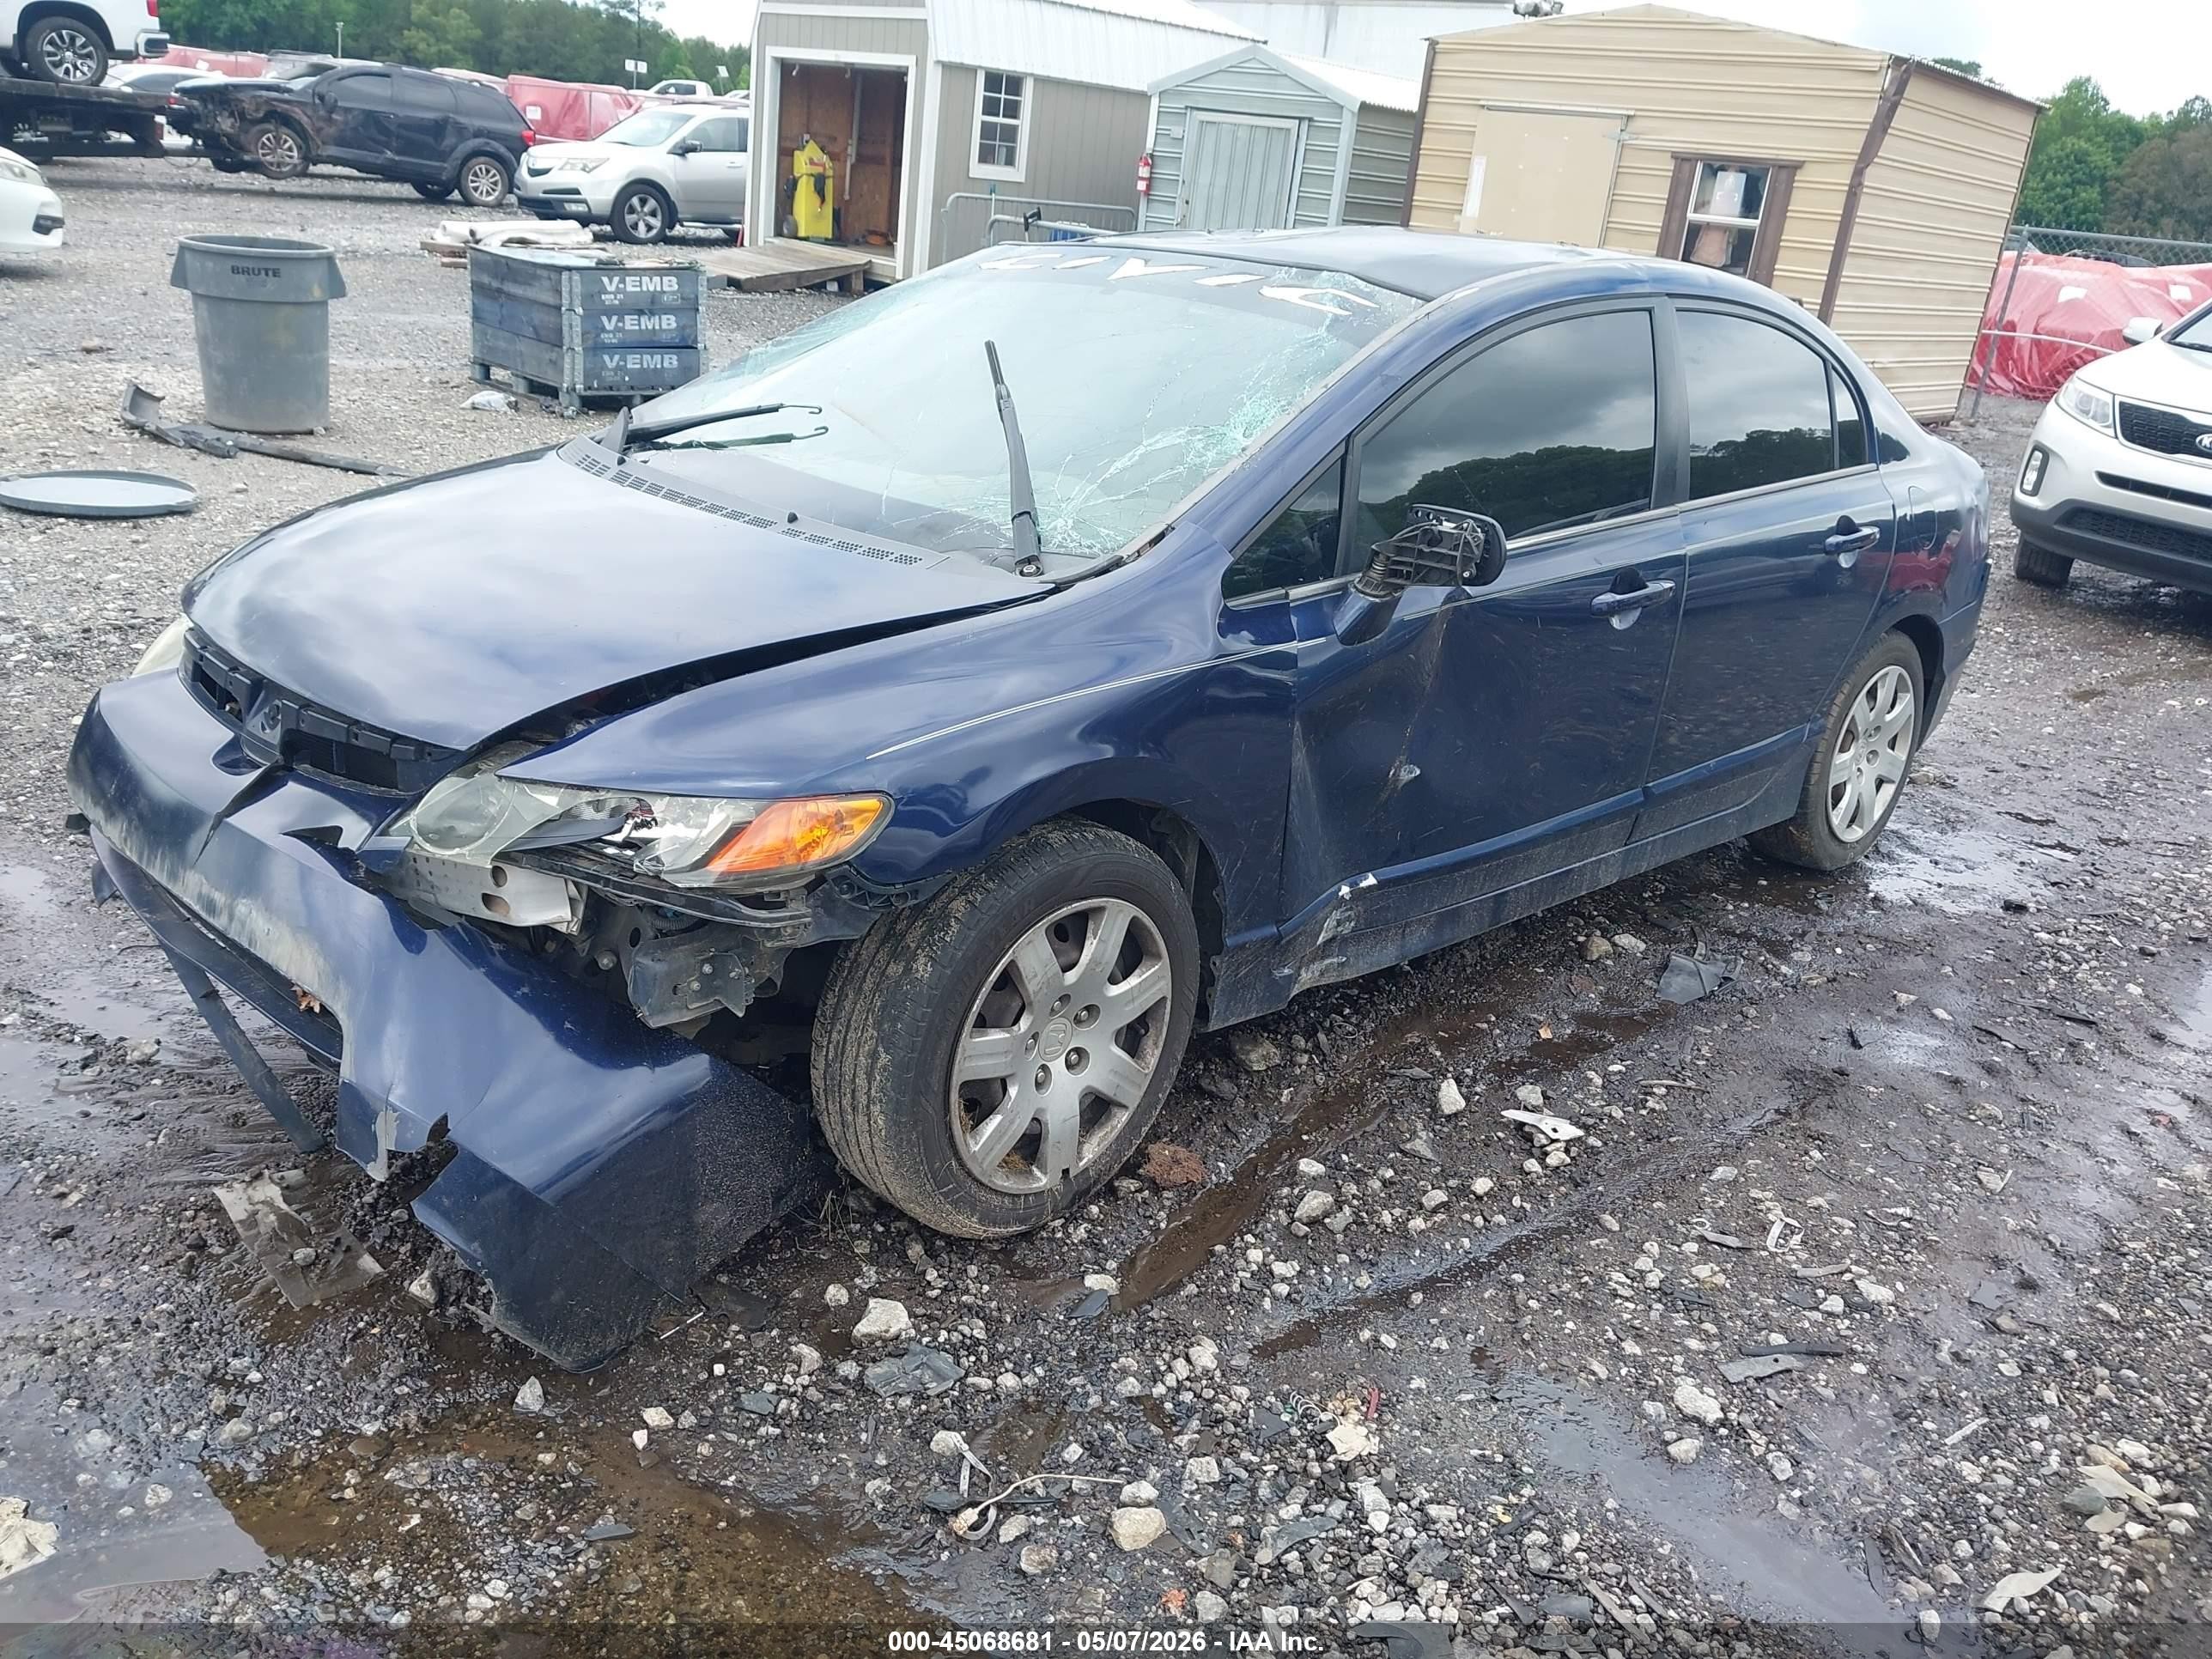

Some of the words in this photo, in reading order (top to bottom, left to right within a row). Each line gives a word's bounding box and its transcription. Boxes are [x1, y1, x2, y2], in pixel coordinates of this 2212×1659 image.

[231, 264, 282, 278] BRUTE
[601, 276, 679, 292] V-EMB
[600, 314, 678, 331] V-EMB
[603, 354, 678, 368] V-EMB
